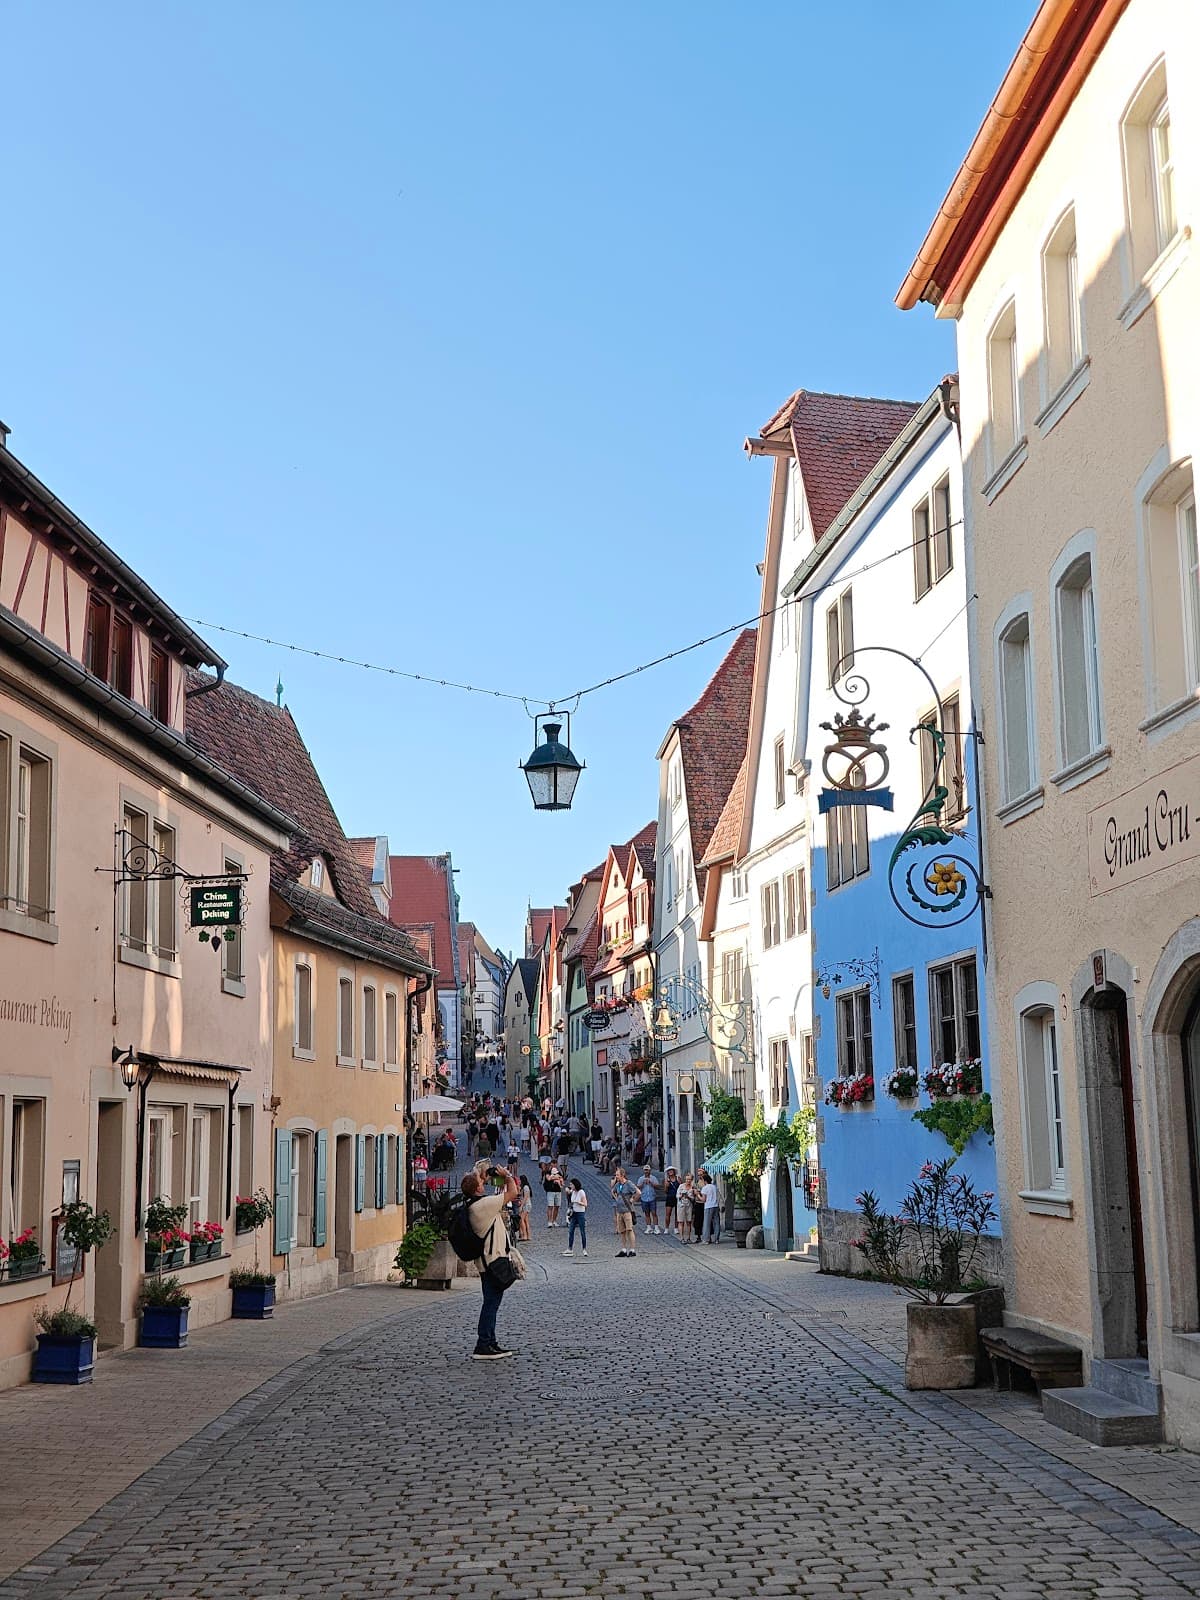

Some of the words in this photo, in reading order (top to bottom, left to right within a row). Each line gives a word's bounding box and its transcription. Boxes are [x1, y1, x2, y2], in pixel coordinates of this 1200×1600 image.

[1104, 805, 1151, 878] Grand
[1154, 789, 1191, 852] Cru
[203, 892, 228, 901] China
[197, 901, 234, 909] Restaurant
[201, 909, 230, 921] Peking
[0, 999, 37, 1025] aurant
[40, 995, 72, 1044] Peking
